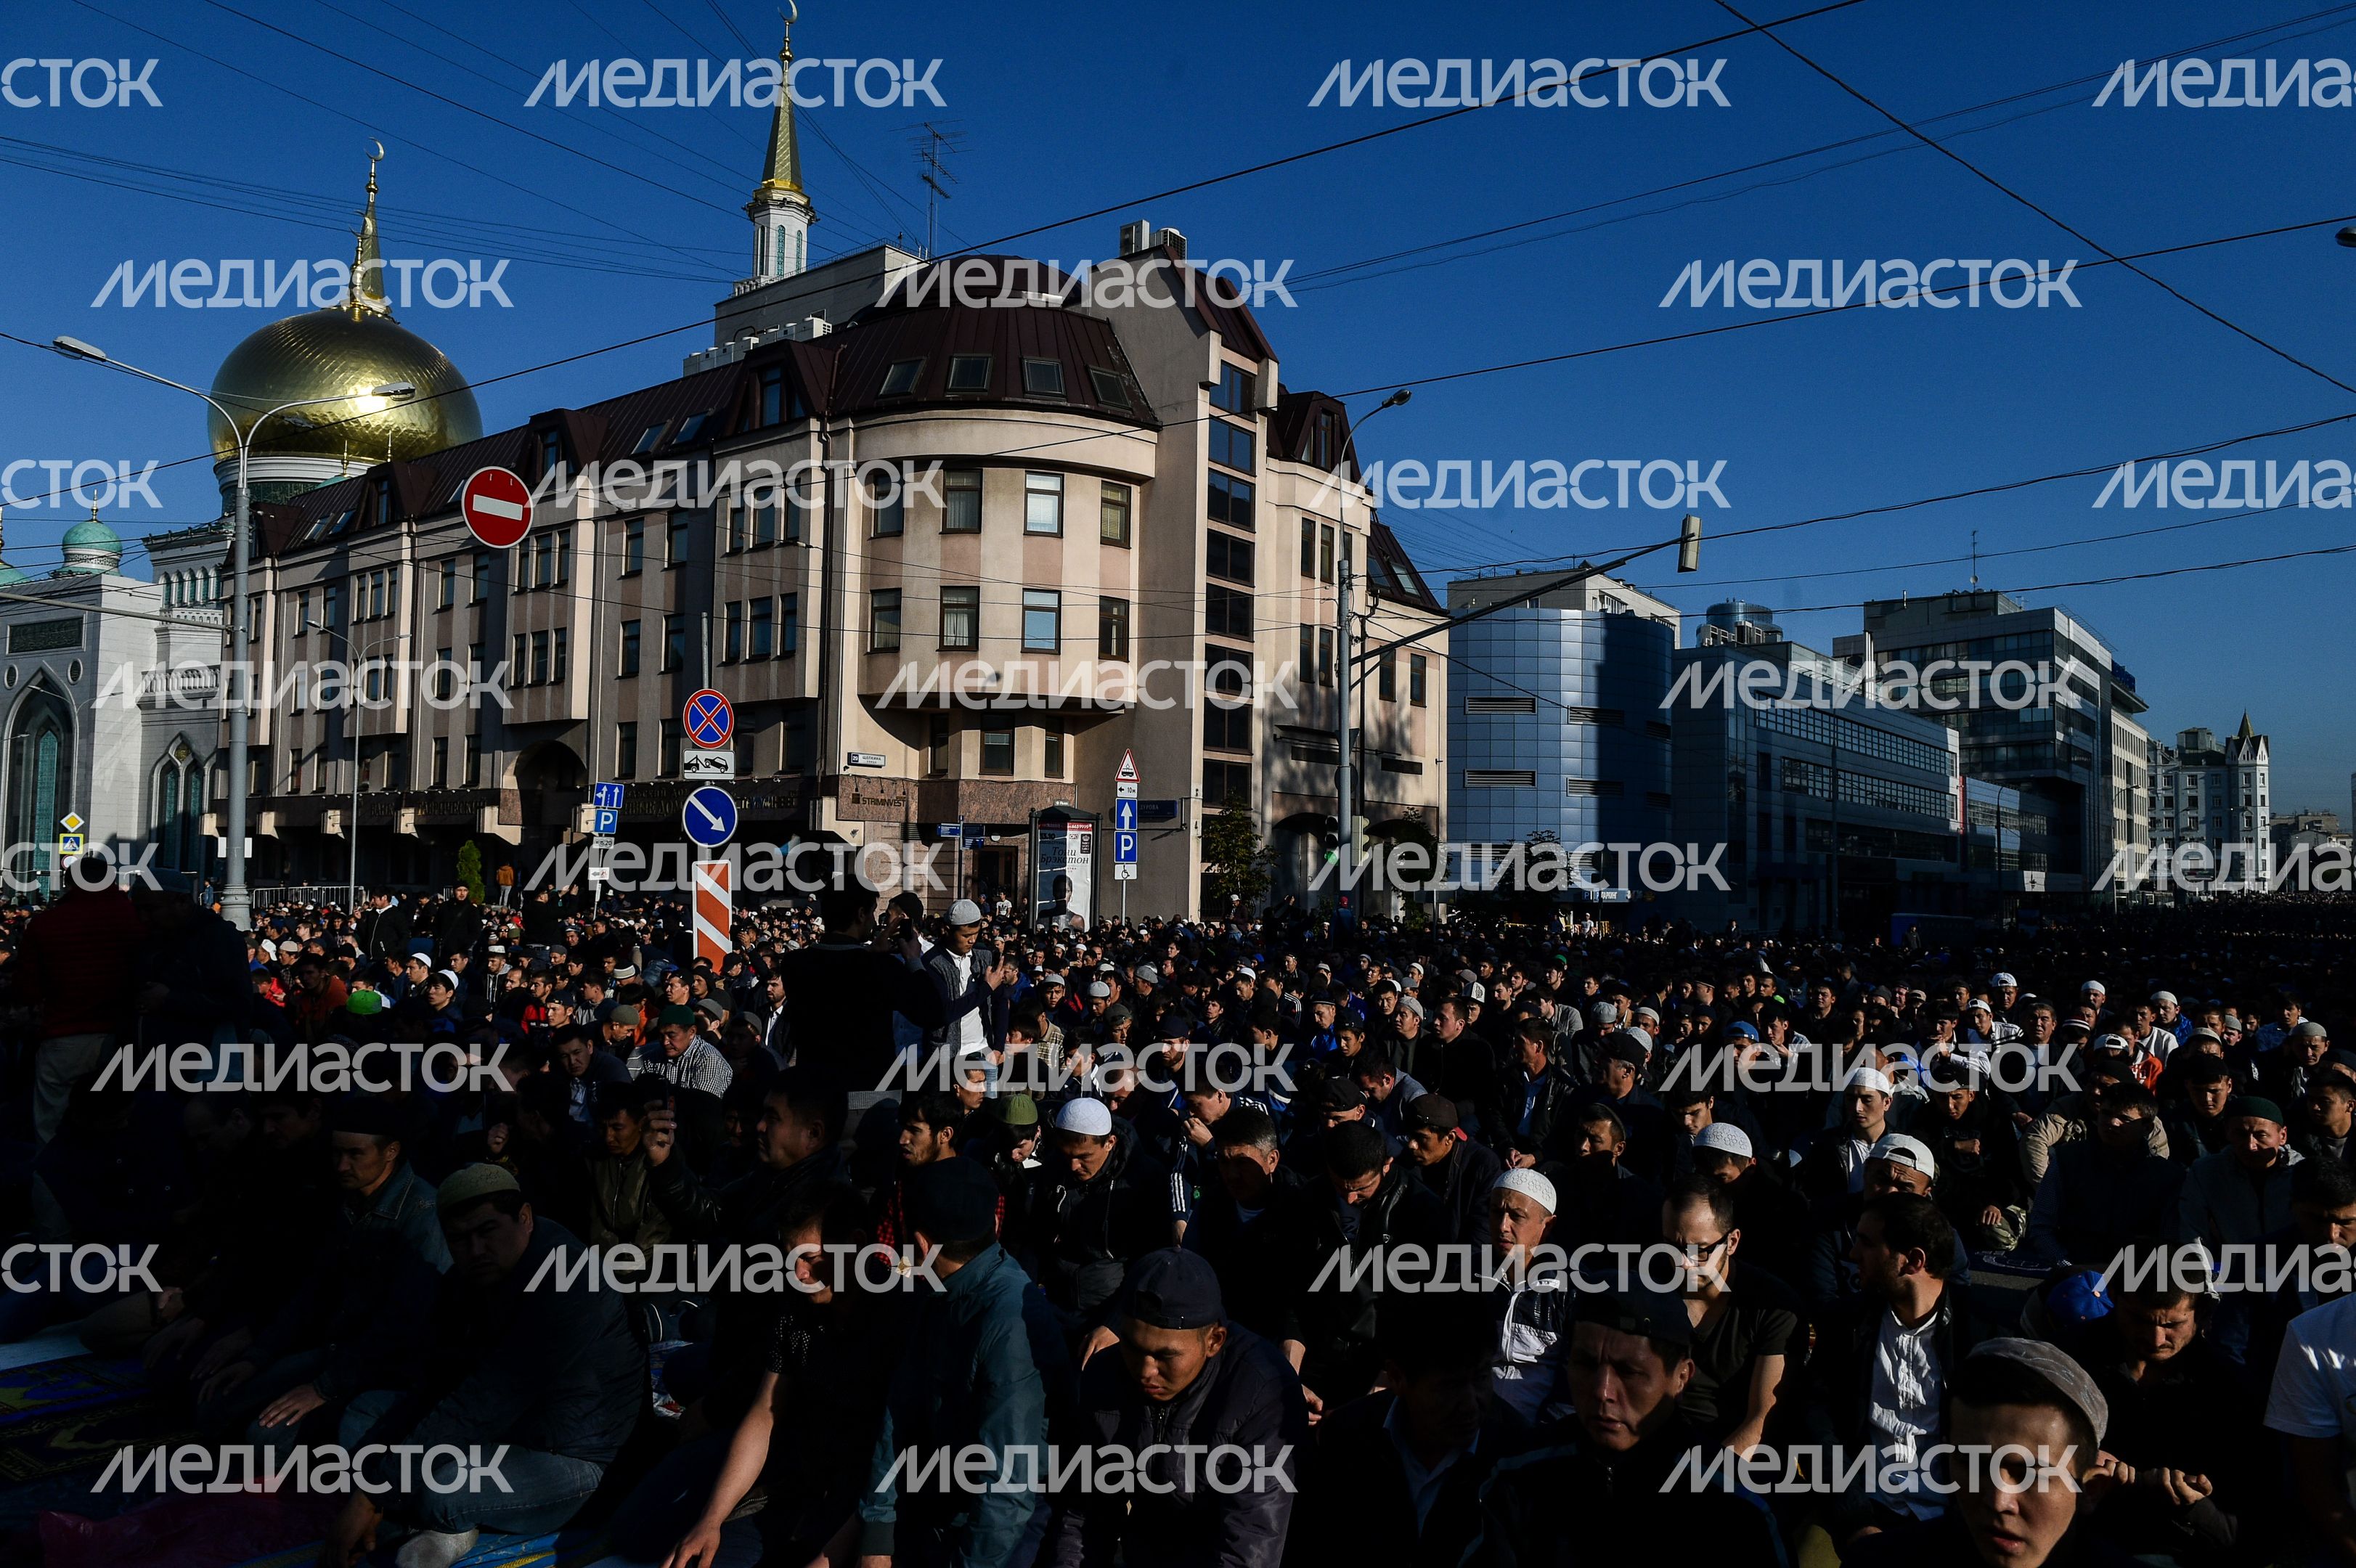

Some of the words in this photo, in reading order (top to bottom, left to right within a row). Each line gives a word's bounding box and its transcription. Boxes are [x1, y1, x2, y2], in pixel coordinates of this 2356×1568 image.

[862, 797, 905, 807] STRIMINVEST
[599, 812, 614, 830] P
[1052, 846, 1077, 857] Тони
[1120, 834, 1134, 859] P
[1040, 854, 1089, 865] Брэкстон
